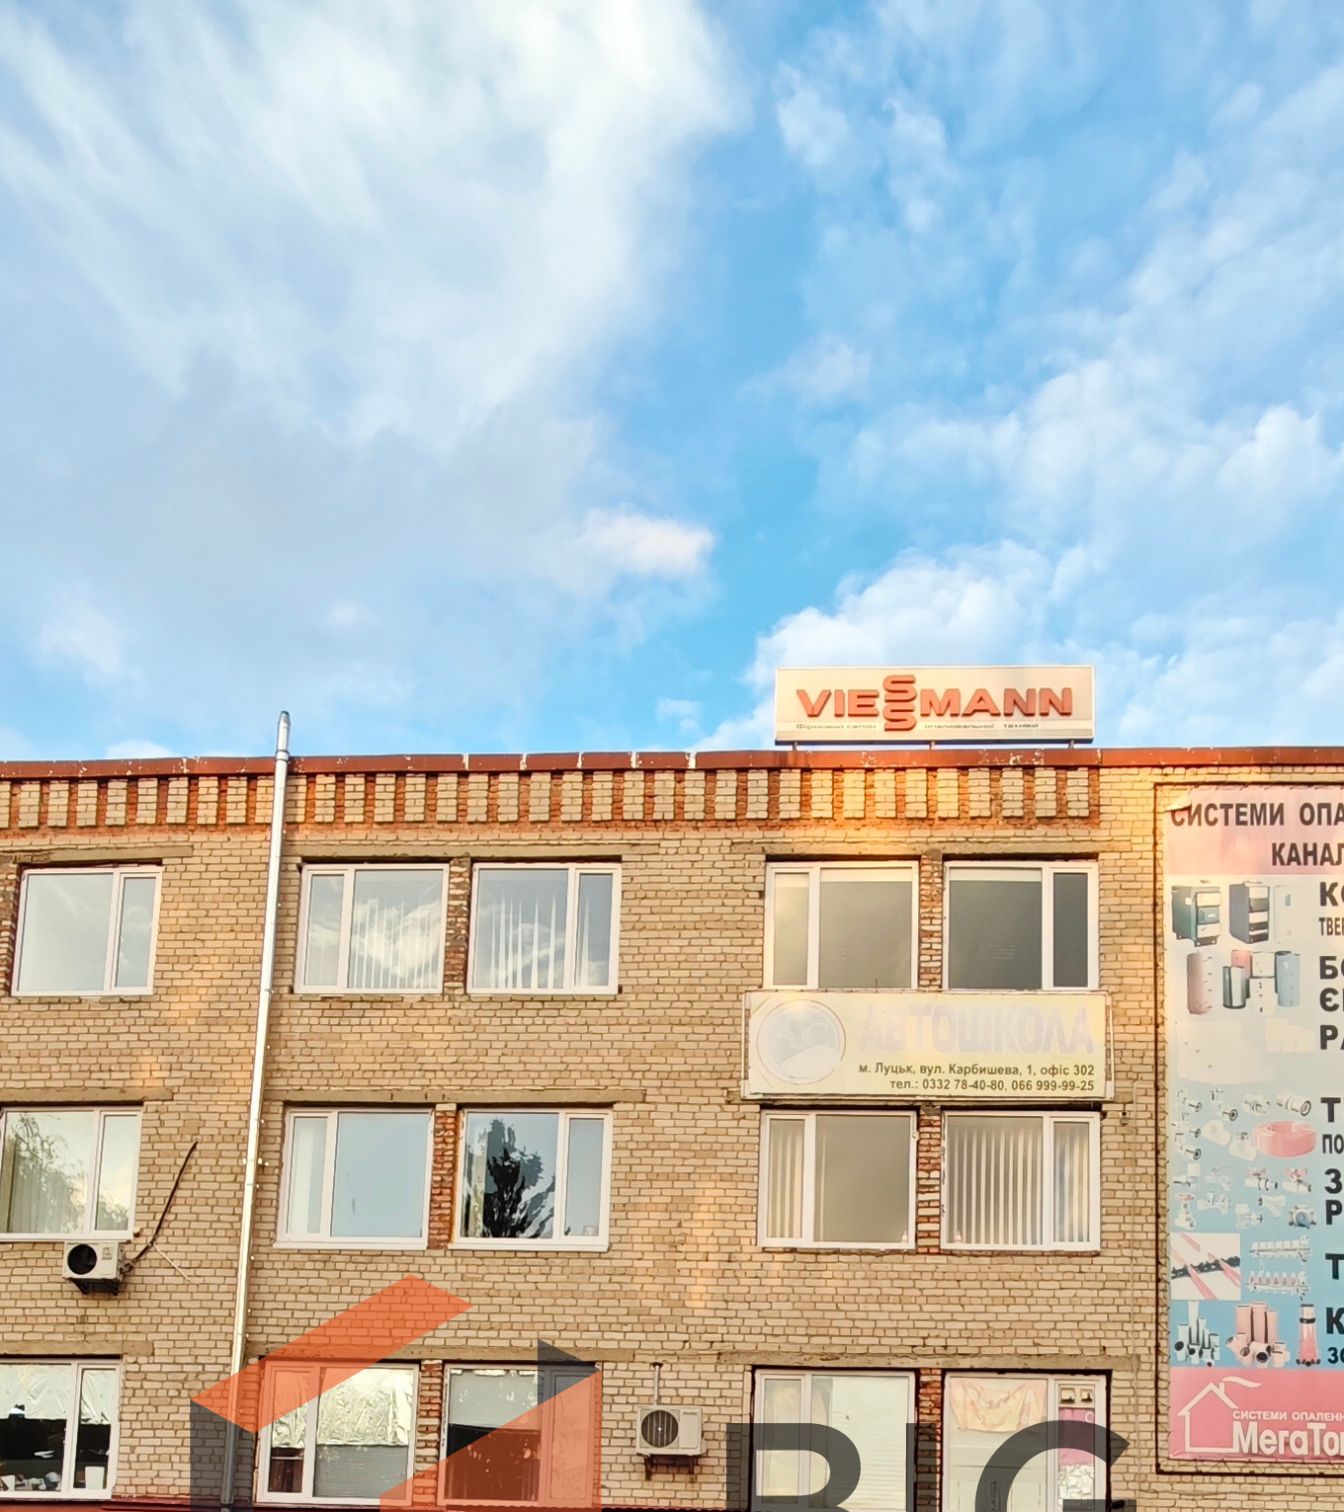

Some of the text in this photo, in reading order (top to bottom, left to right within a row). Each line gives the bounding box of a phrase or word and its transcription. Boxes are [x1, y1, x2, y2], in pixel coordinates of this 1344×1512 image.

[796, 674, 1073, 732] VIESSMANN
[1170, 802, 1285, 827] СИСТЕМИ
[860, 1004, 1095, 1055] АВТОШКОЛА
[859, 1066, 871, 1074] м.
[875, 1062, 916, 1077] Луцьк,
[919, 1064, 945, 1076] вул.
[948, 1062, 1024, 1078] Карбишева,
[1040, 1062, 1071, 1078] офіс
[1073, 1064, 1095, 1076] 302
[922, 1079, 951, 1091] 0332
[954, 1079, 1008, 1092] 78-40-80,
[1011, 1079, 1033, 1091] 066
[1036, 1080, 1095, 1092] 999-99-25
[1232, 1409, 1287, 1422] СИСТЕМИ
